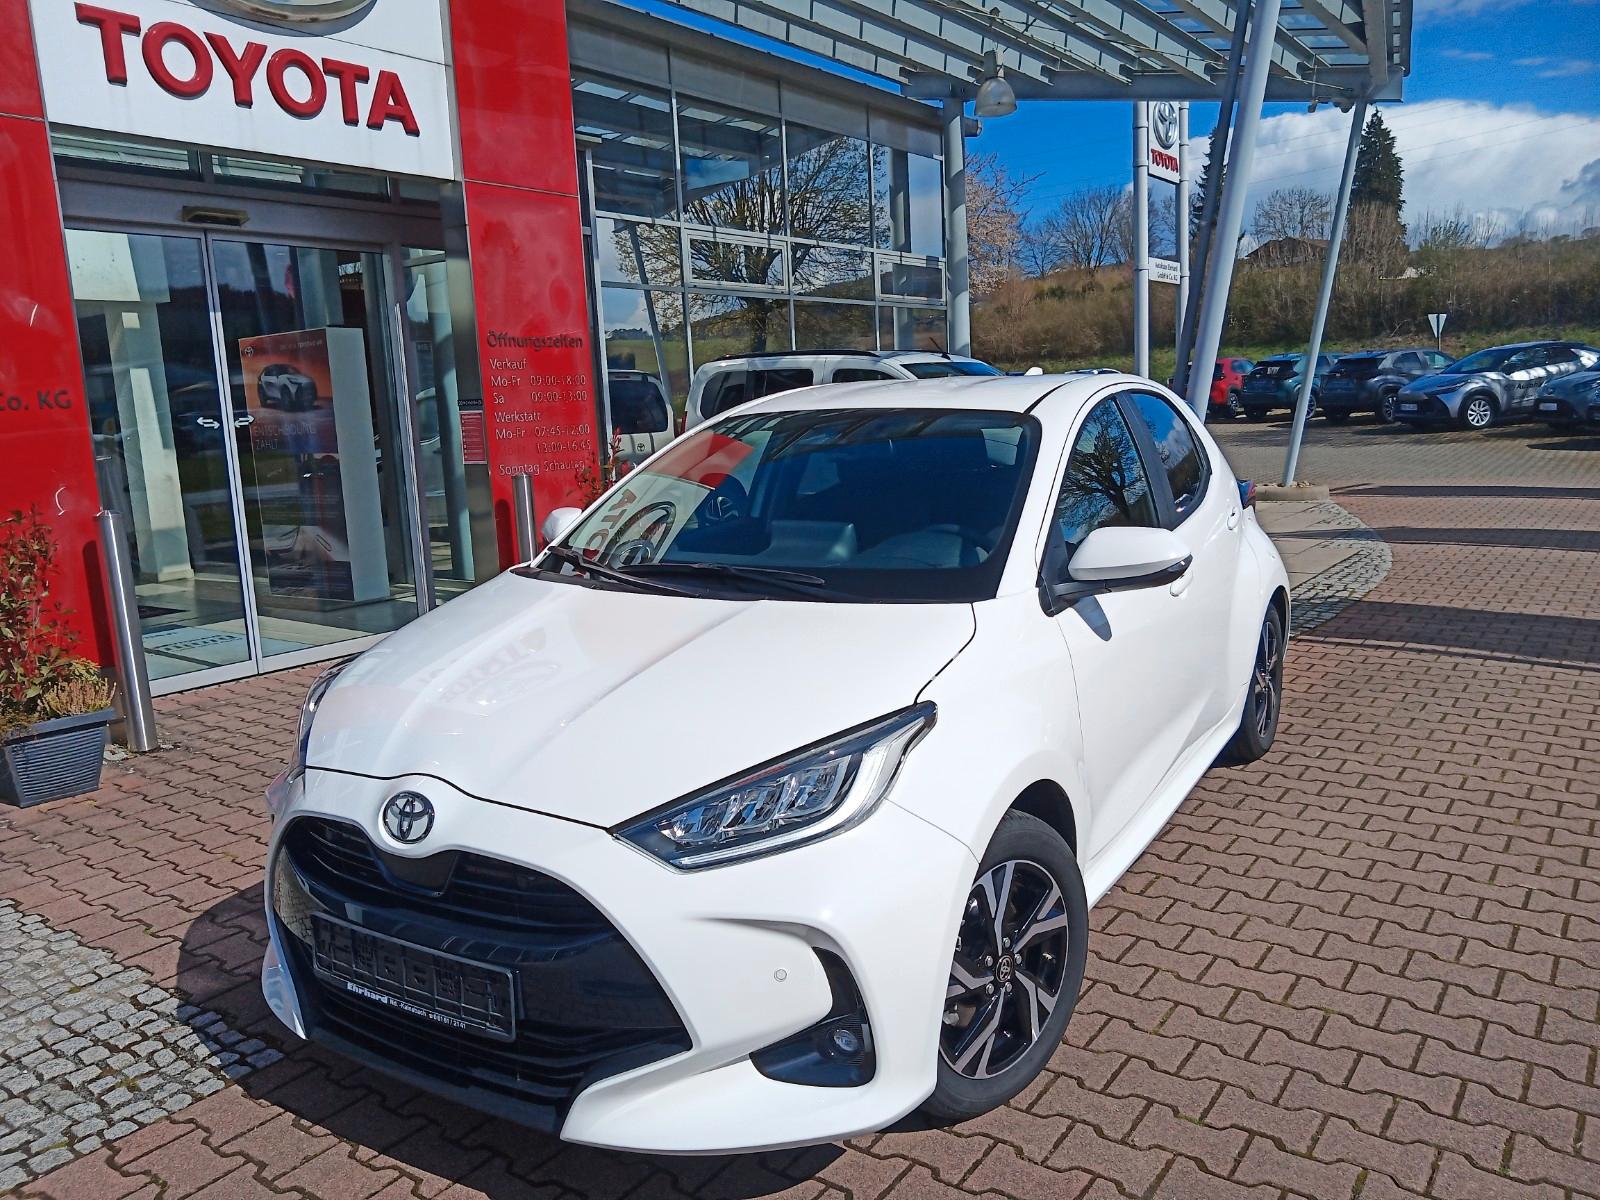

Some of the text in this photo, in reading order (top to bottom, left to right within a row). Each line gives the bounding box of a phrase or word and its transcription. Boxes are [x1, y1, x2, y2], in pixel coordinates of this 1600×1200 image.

[74, 2, 420, 138] TOYOTA
[1151, 148, 1179, 173] TOYOTA
[486, 331, 583, 351] Öffnungszeiten
[489, 359, 528, 370] Verkauf
[491, 375, 586, 387] Mo-Fr 09:00-18:00
[0, 388, 72, 411] o. KG
[493, 392, 505, 404] Sa
[531, 390, 588, 403] 09:00-13:00
[495, 428, 526, 440] Mo-Fr
[499, 463, 540, 476] Sonntag
[346, 981, 388, 1004] Ehrhard
